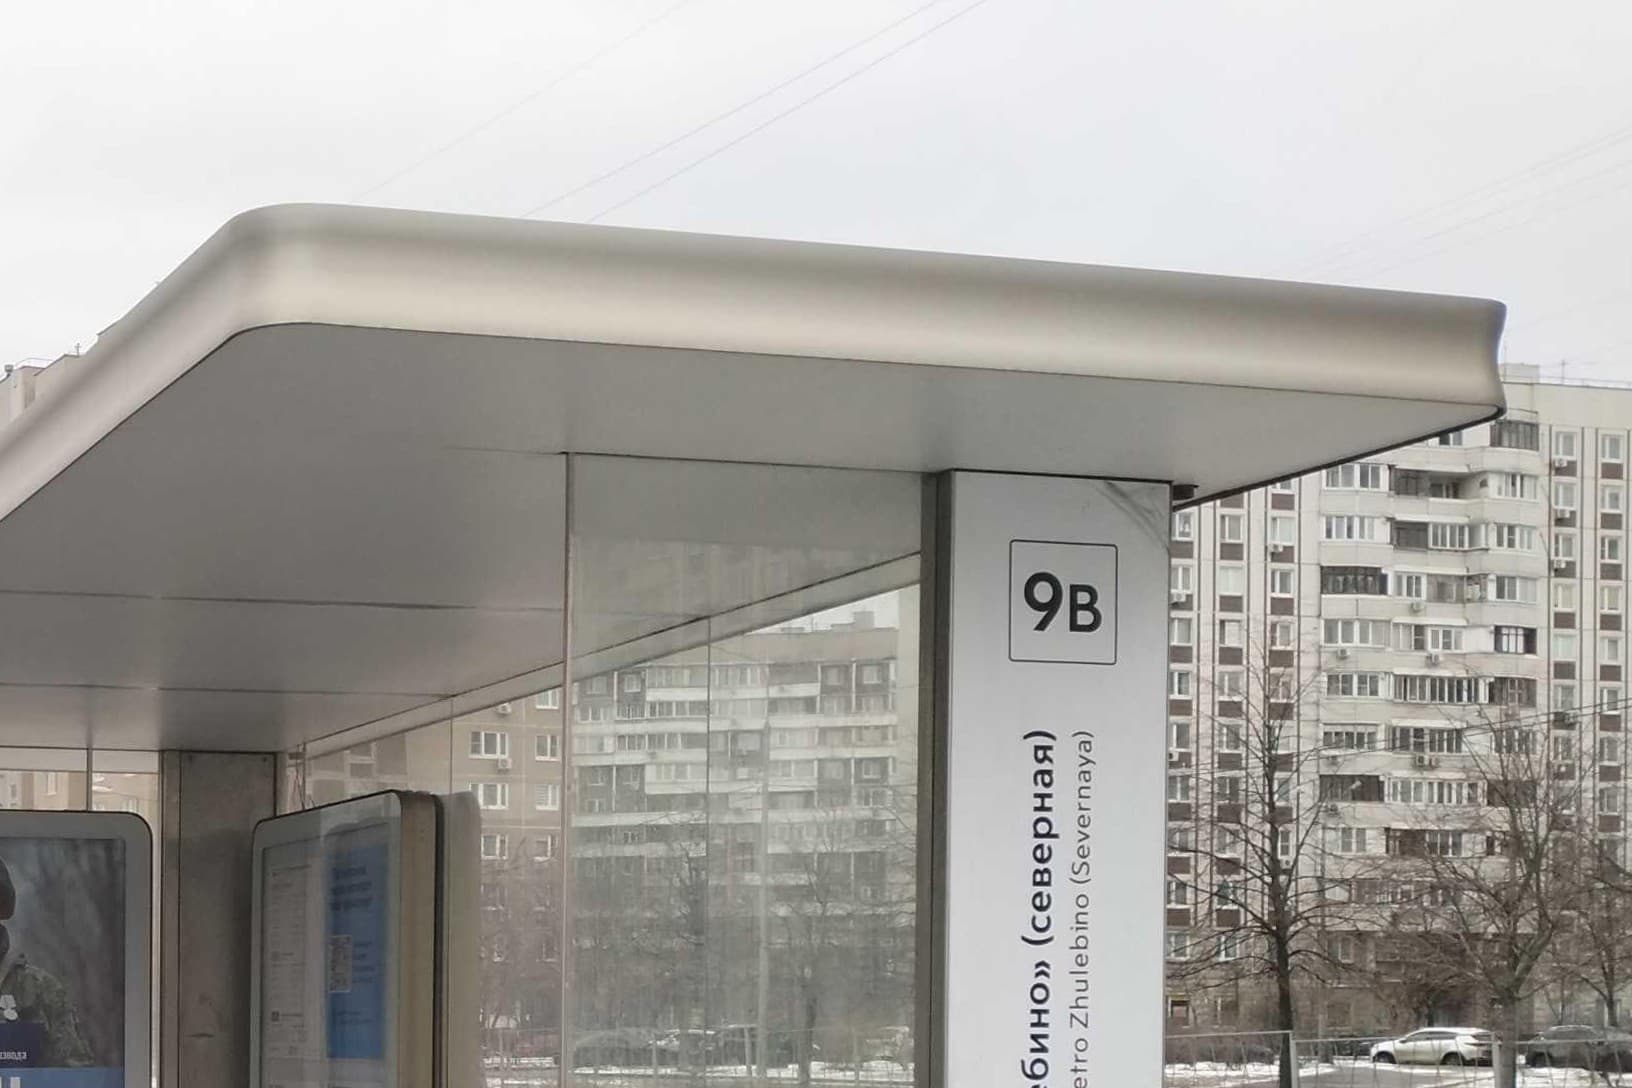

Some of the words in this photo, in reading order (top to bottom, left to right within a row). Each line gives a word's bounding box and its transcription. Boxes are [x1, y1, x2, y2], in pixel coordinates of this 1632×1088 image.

[1020, 730, 1060, 946] (северная)
[1069, 731, 1097, 885] (Severnaya)
[1068, 893, 1090, 1029] Zhulebino
